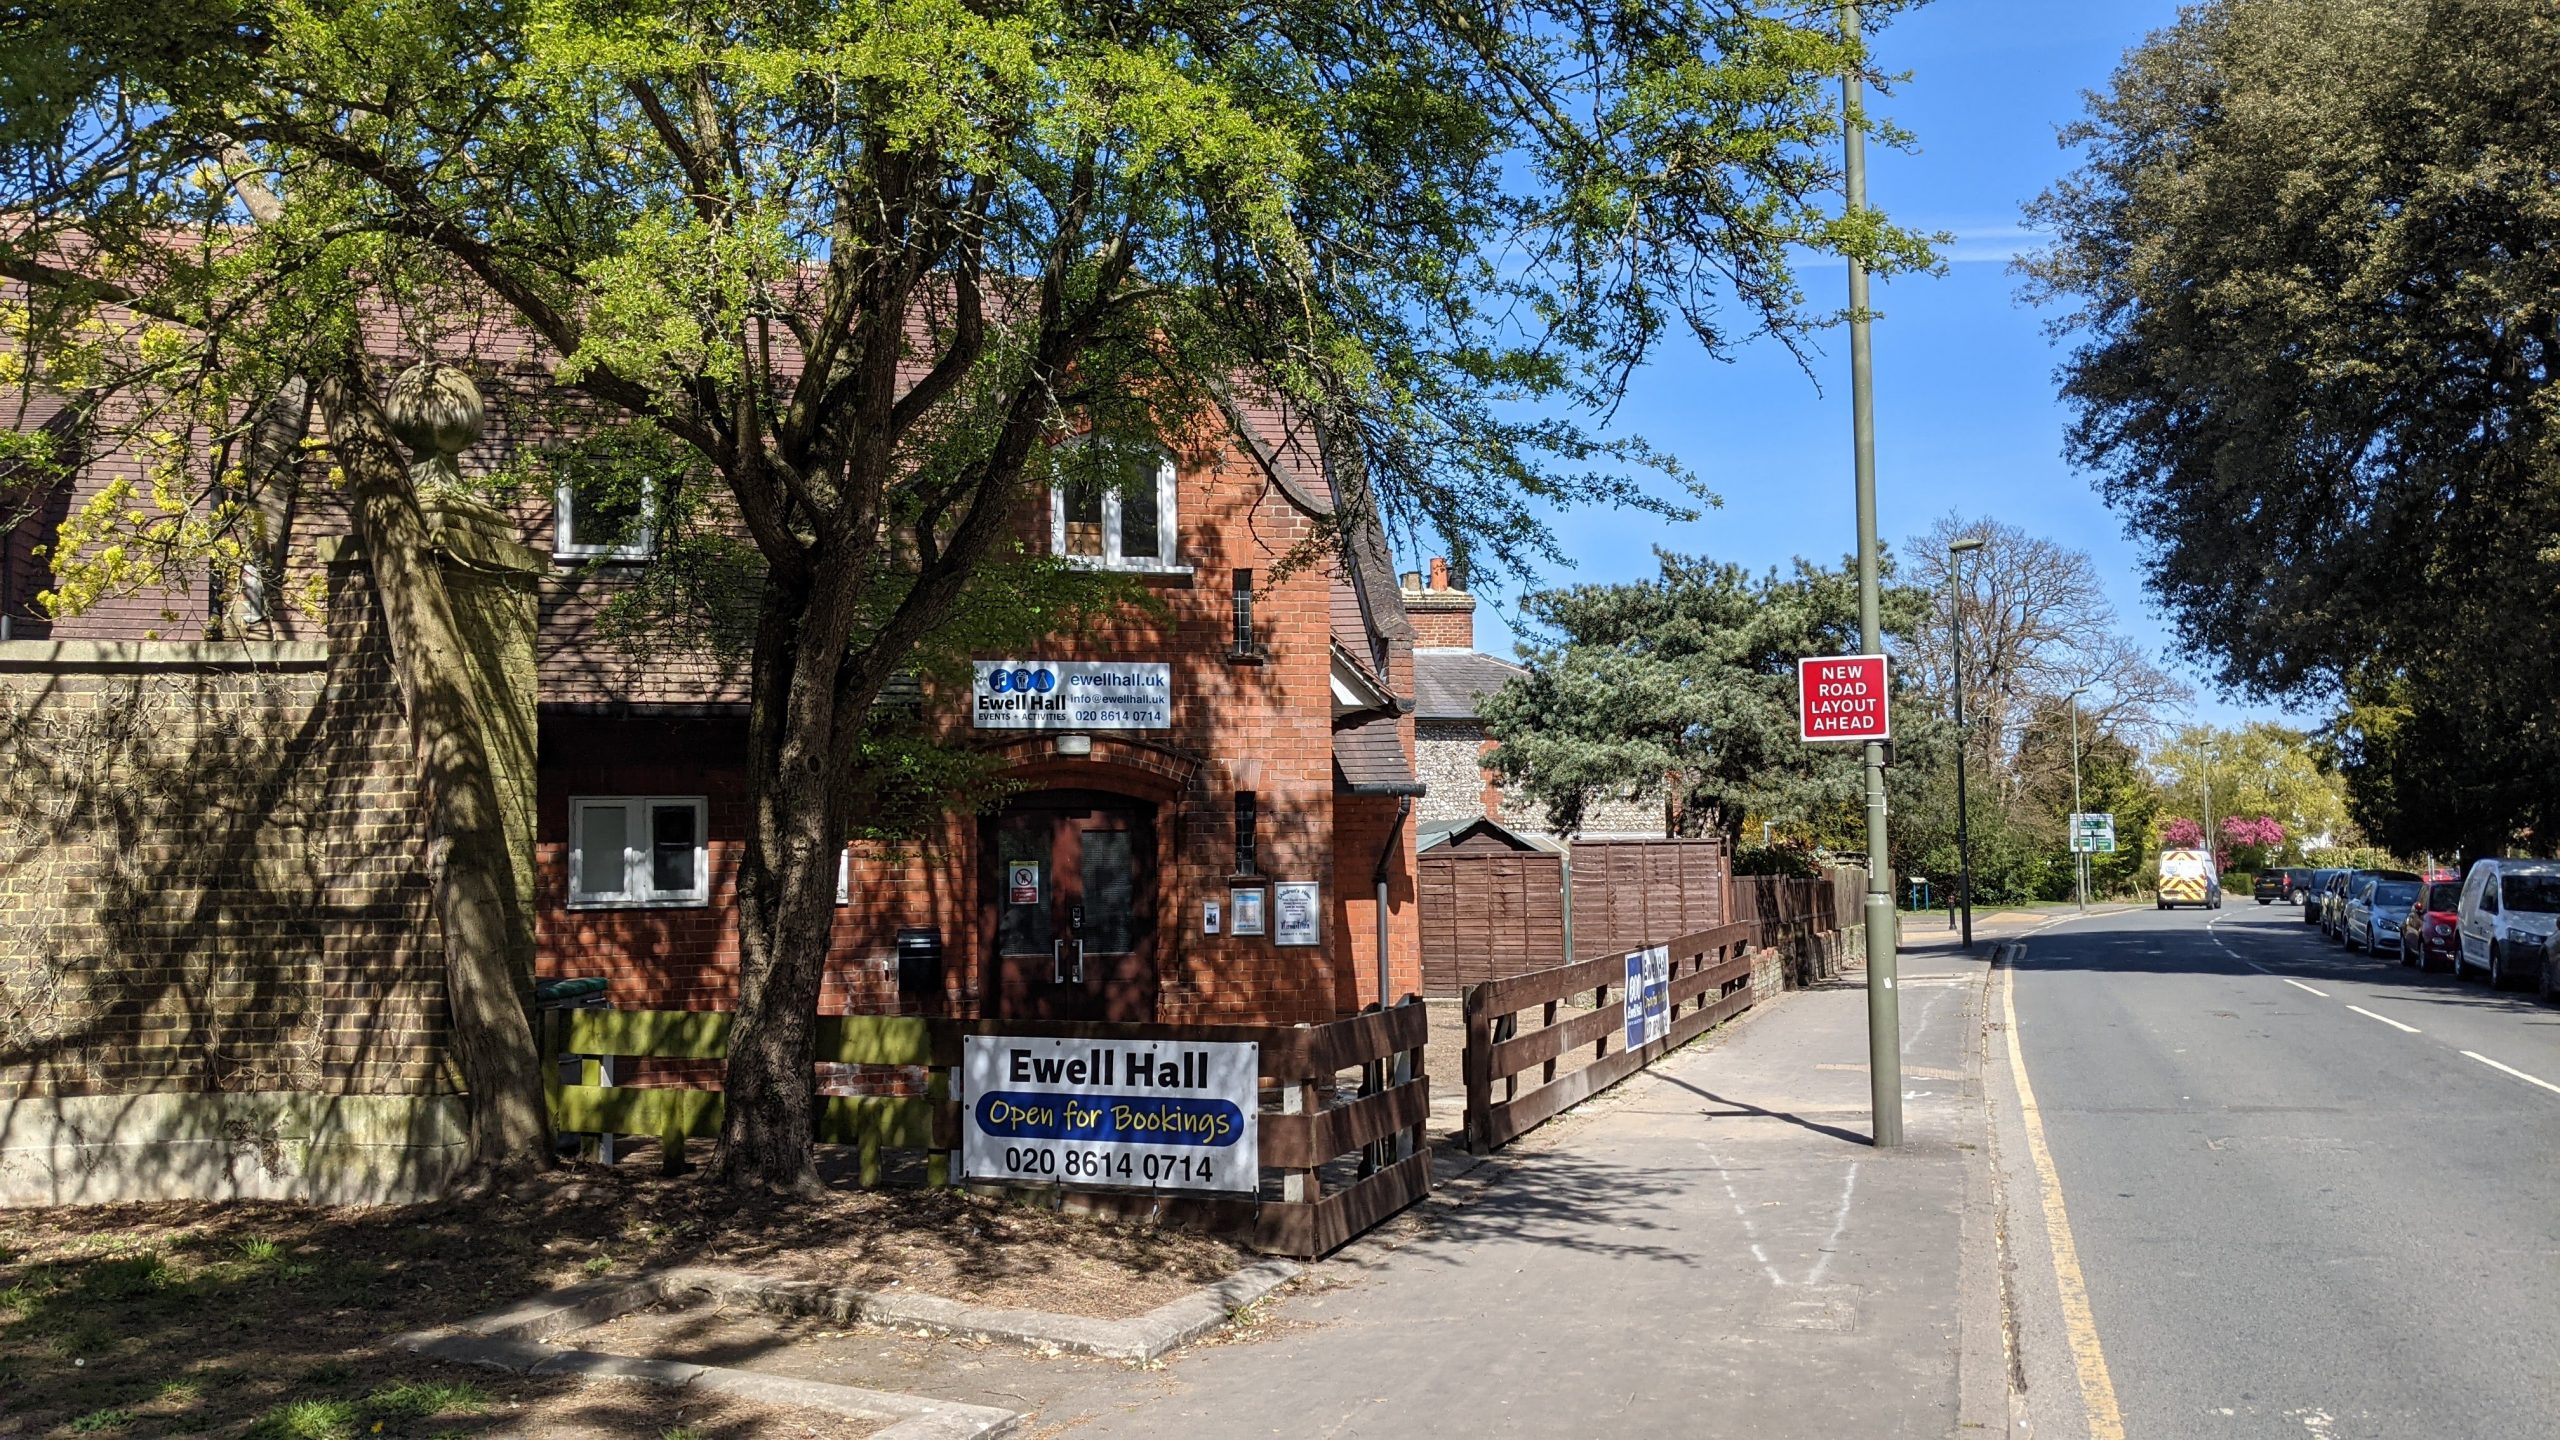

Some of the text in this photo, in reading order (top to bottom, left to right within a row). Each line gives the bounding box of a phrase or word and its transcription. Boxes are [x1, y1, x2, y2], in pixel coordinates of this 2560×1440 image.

[1070, 672, 1165, 687] ewellhall.uk
[1822, 666, 1862, 680] NEW
[1819, 682, 1867, 697] ROAD
[978, 695, 1066, 711] Ewell Hall
[1070, 694, 1165, 704] info@ewellhall.uk
[1811, 699, 1877, 714] LAYOUT
[978, 713, 1011, 721] EVENTS
[1021, 713, 1067, 721] ACTIVITIES
[1075, 711, 1161, 722] 020 8614 0714
[1813, 716, 1875, 731] AHEAD
[1009, 1049, 1208, 1089] Ewell Hall
[989, 1099, 1230, 1144] Open for Bookings
[1005, 1147, 1213, 1183] 020 8614 0714
